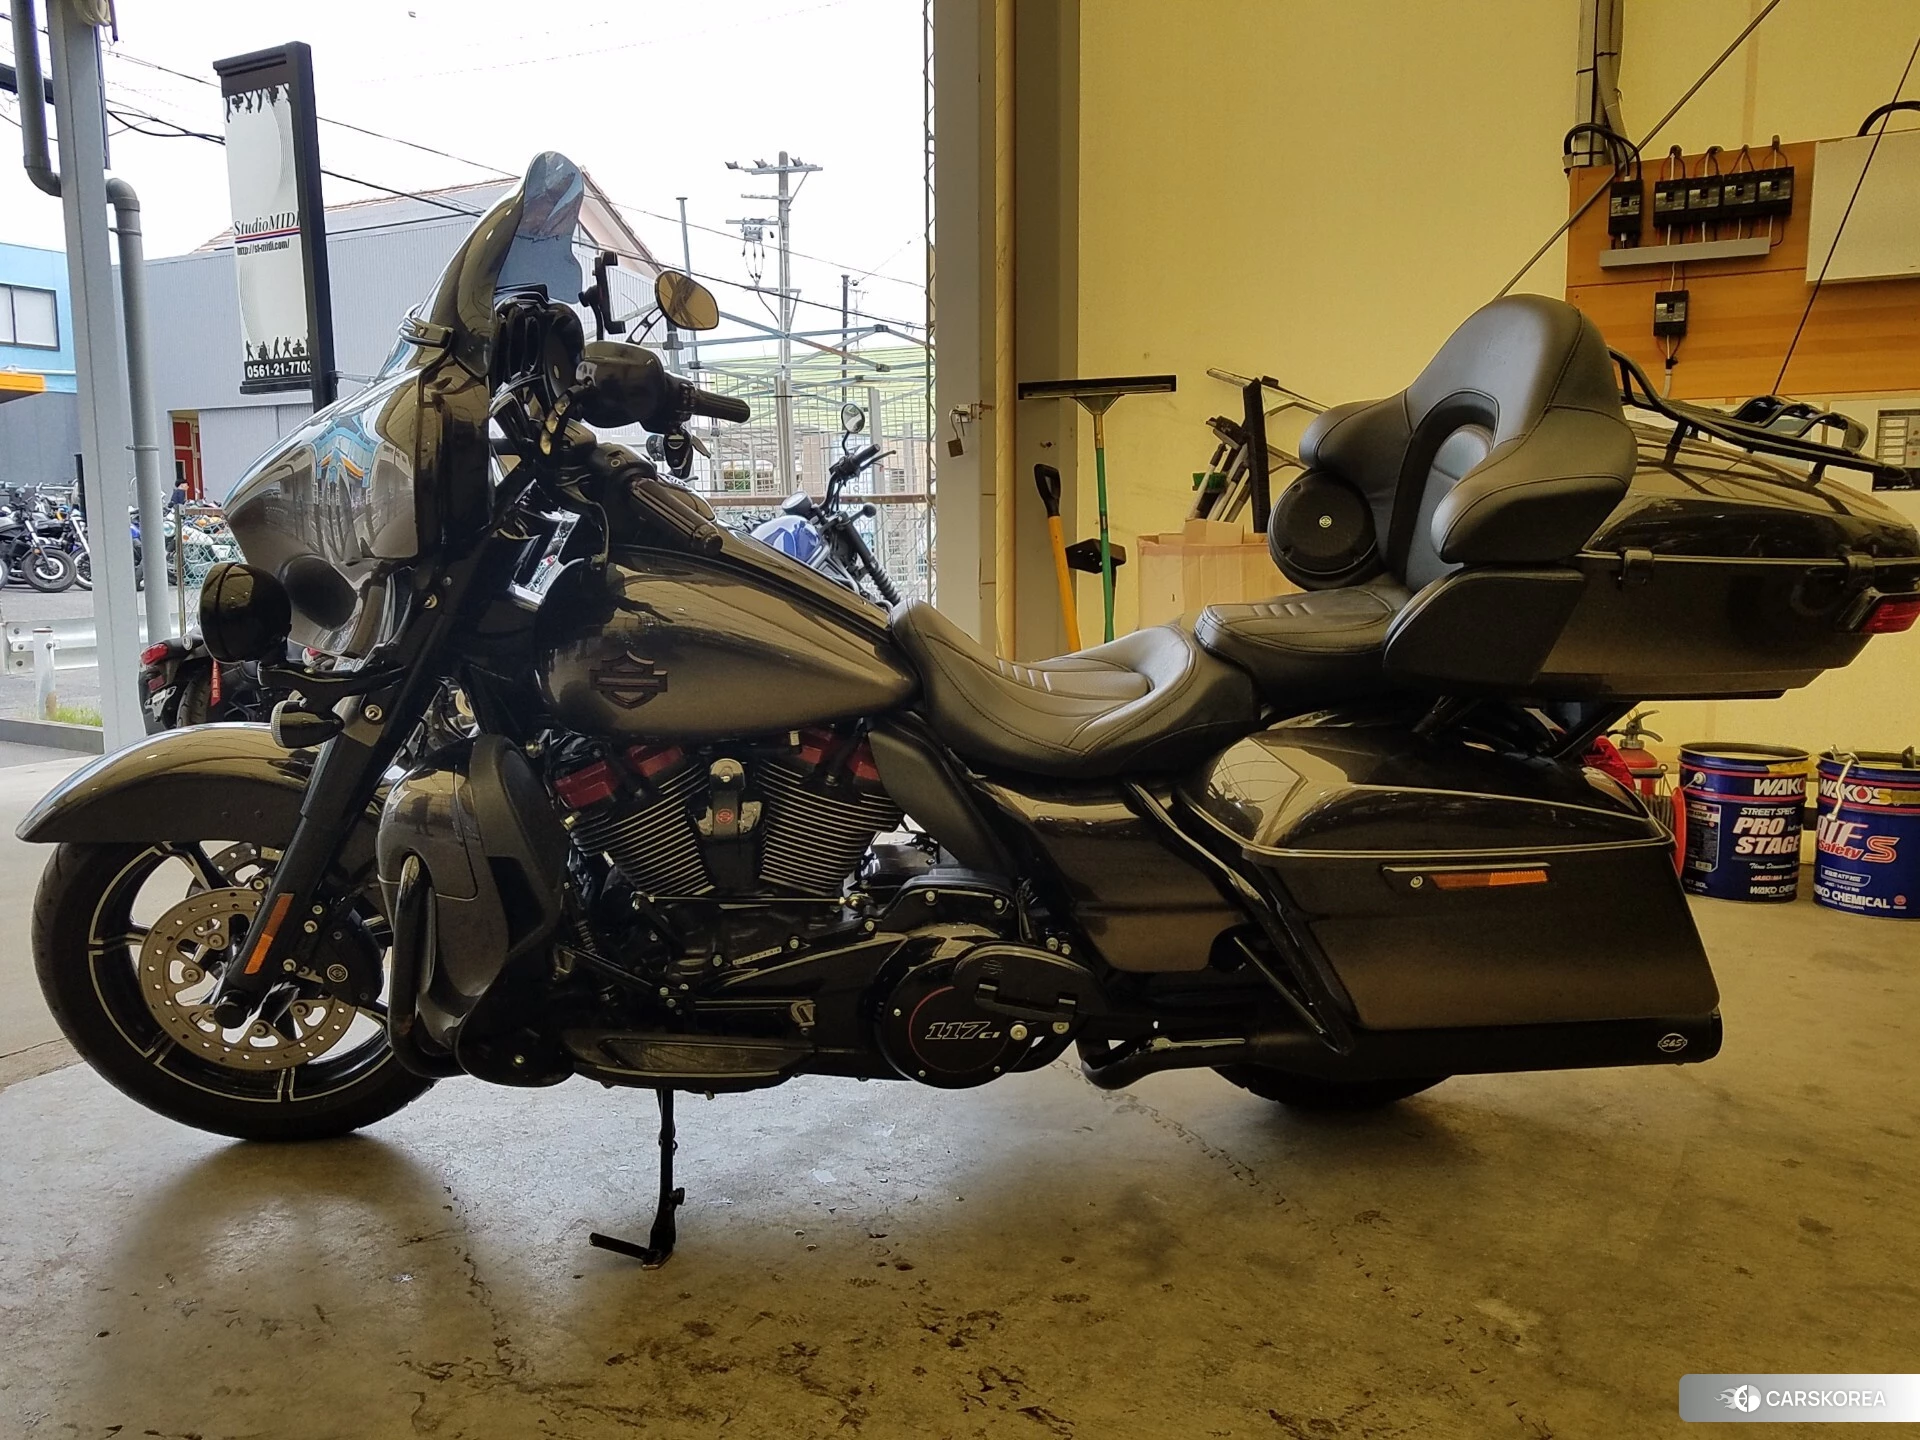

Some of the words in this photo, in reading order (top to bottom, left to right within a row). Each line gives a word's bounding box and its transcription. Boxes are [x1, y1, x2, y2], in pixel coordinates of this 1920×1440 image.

[1740, 807, 1776, 816] STREET
[1775, 807, 1797, 816] SPEC
[1732, 817, 1786, 835] PRO
[1819, 840, 1865, 860] Safety
[1861, 835, 1900, 863] S
[1832, 890, 1891, 909] CHEMICAL
[925, 1021, 991, 1040] 117
